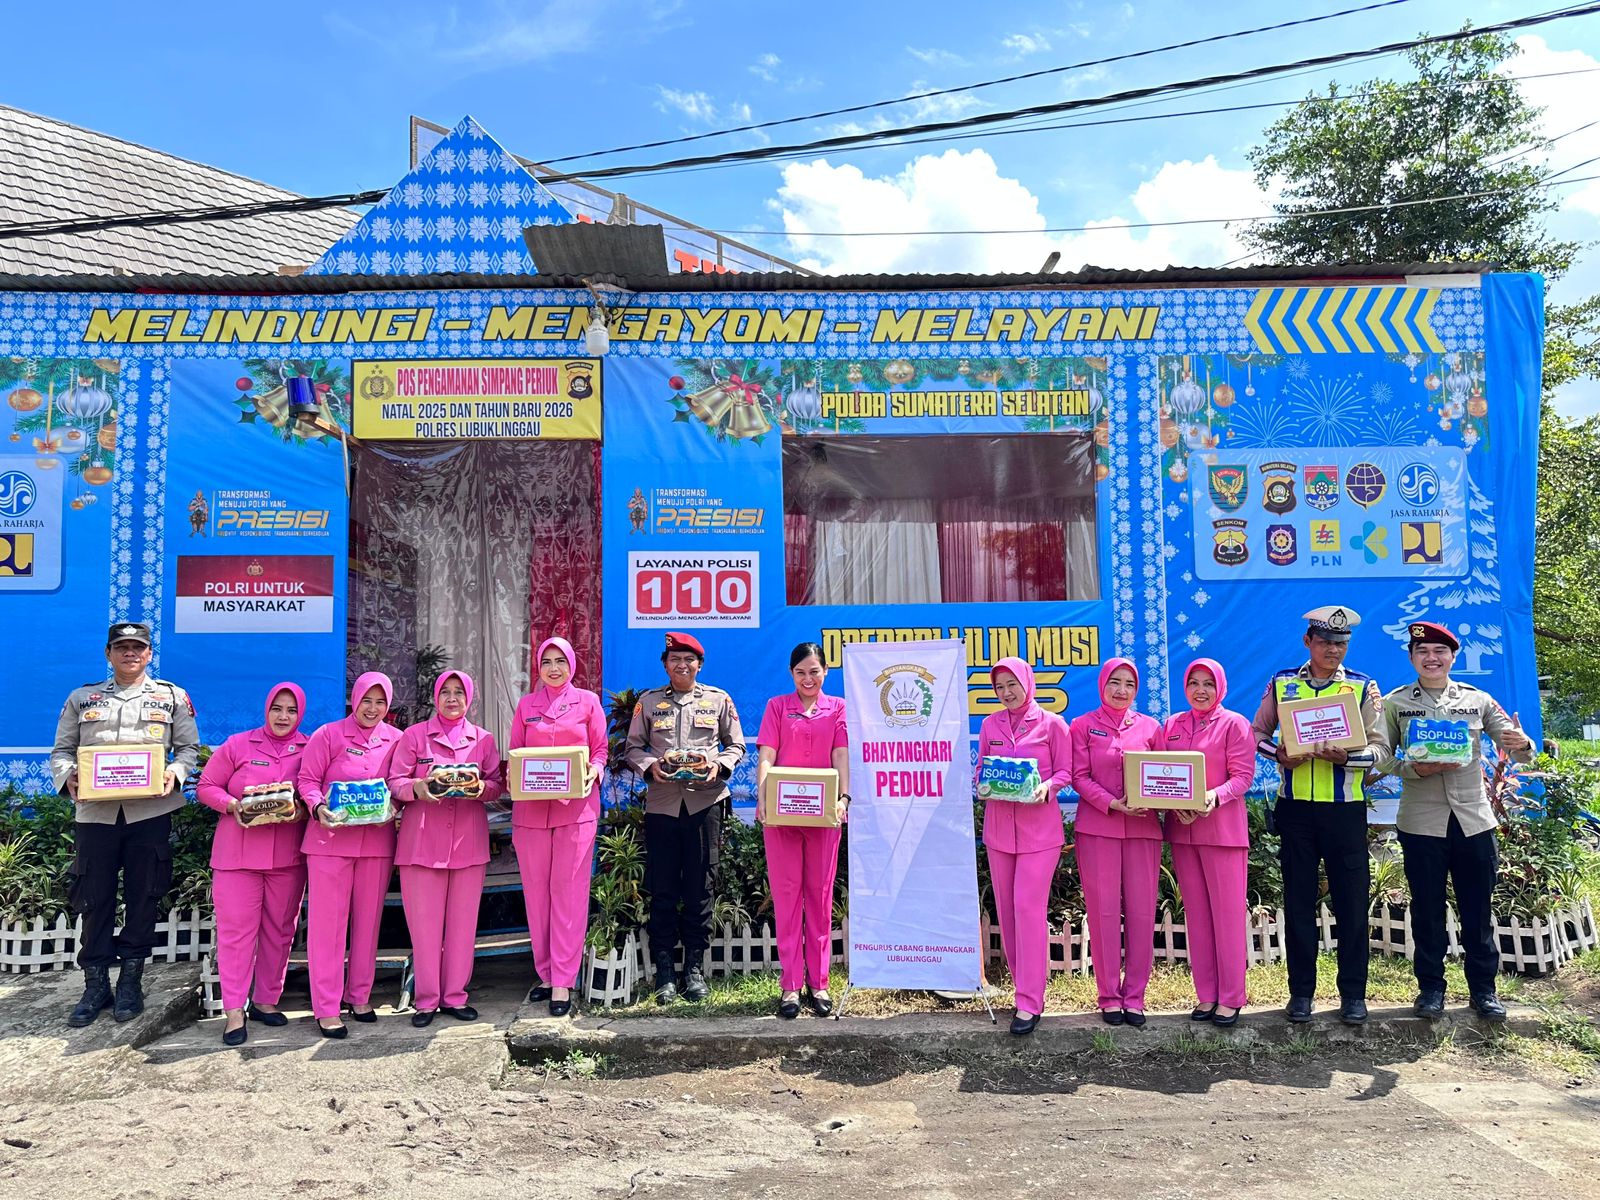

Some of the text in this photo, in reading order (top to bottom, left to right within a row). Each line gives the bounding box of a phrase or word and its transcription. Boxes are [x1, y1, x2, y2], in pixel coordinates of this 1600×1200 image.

[82, 306, 435, 343] MELINDUNGI
[870, 306, 1160, 343] MELAYANI
[397, 367, 558, 396] POS PENGAMANAN SIMPANG PERIUK
[821, 390, 1090, 418] POLDA SUMATERA SELATAN
[382, 402, 573, 419] NATAL 2025 DAN TAHUN BARU 2026
[416, 421, 540, 438] POLRES LUBUKLINGGAU
[218, 490, 271, 499] TRANSFORMASI
[656, 488, 707, 497] TRANSFORMASI
[218, 500, 287, 508] MENUJU POLRI YANG
[656, 498, 723, 506] MENUJU POLRI YANG
[217, 510, 330, 529] PRESISI
[656, 508, 764, 527] PRESISI
[1391, 509, 1449, 518] JASA RAHARJA
[3, 520, 45, 529] RAHARJA
[636, 559, 752, 568] LAYANAN POLISI
[1311, 555, 1342, 567] PLN
[204, 582, 305, 594] POLRI UNTUK
[641, 577, 748, 608] 110
[203, 600, 306, 612] MASYARAKAT
[948, 626, 1019, 667] ILIN
[1025, 625, 1100, 666] MUSI
[143, 701, 172, 712] POLRI
[1416, 730, 1464, 740] ISOPLUS
[862, 740, 953, 763] BHAYANGKARI
[1434, 742, 1463, 751] COCO
[982, 767, 1022, 780] ISOPLUS
[875, 770, 943, 798] PEDULI
[997, 780, 1021, 790] COCO
[338, 791, 383, 804] ISOPLUS
[252, 801, 279, 810] GOLDA
[355, 803, 381, 812] COCO
[854, 943, 976, 954] PENGURUS CABANG BHAYANGKARI
[886, 954, 943, 963] LUBUKLINGGAU
